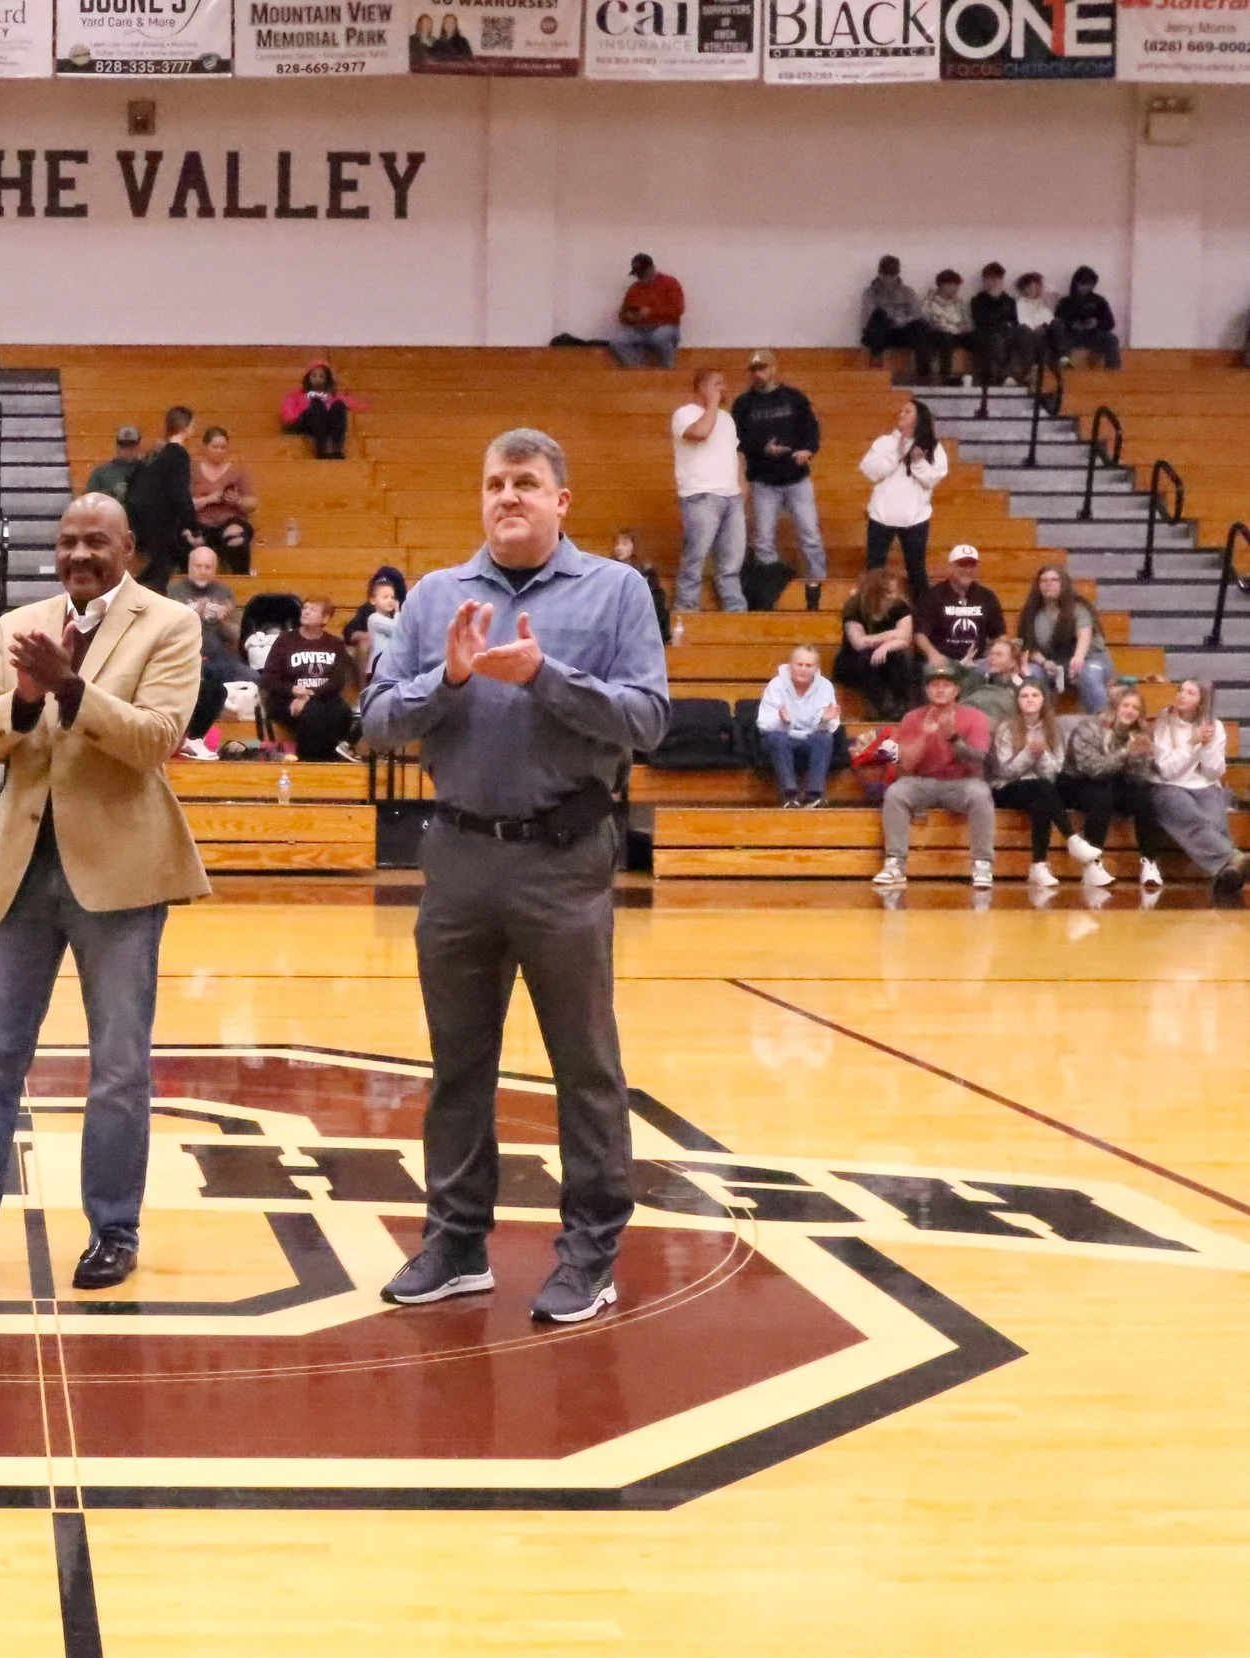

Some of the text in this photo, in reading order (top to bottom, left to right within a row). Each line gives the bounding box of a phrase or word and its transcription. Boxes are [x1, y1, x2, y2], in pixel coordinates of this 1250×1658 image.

[251, 1, 393, 24] MOUNTAIN VIEW
[80, 17, 176, 28] Yard Care & More
[769, 0, 935, 46] BLACK
[944, 0, 1113, 59] ONE
[256, 27, 387, 48] MEMORIAL PARK
[770, 48, 934, 58] ORTHODONTICS
[95, 61, 193, 73] 828-335-3777
[276, 61, 367, 74] 828-669-2977
[116, 150, 426, 220] VALLEY
[290, 651, 336, 668] OWEN
